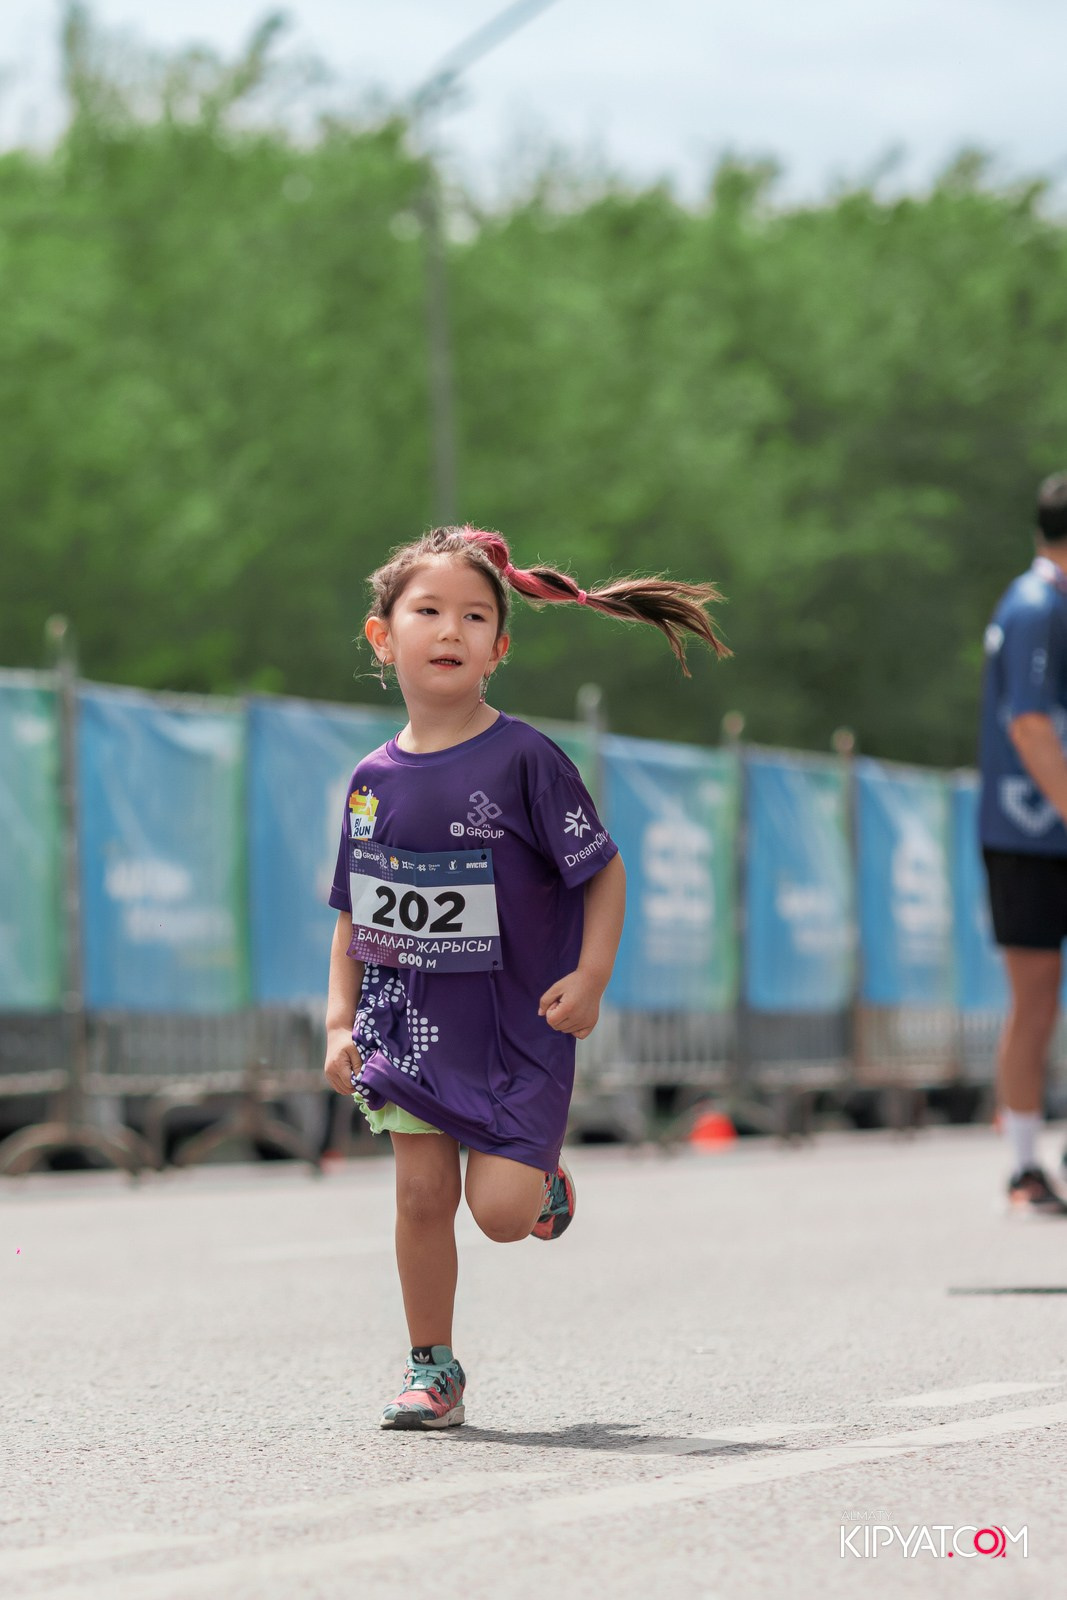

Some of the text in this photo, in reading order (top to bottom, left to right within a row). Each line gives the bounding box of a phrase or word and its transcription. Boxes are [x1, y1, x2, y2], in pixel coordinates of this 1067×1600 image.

[353, 825, 371, 837] RUN
[451, 823, 505, 839] BI GROUP
[362, 851, 380, 862] GROUP
[465, 861, 488, 869] INVICTUS
[371, 885, 466, 933] 202
[357, 928, 492, 954] БАЛАЛАР ЖАРЫСЫ
[398, 952, 423, 967] 600
